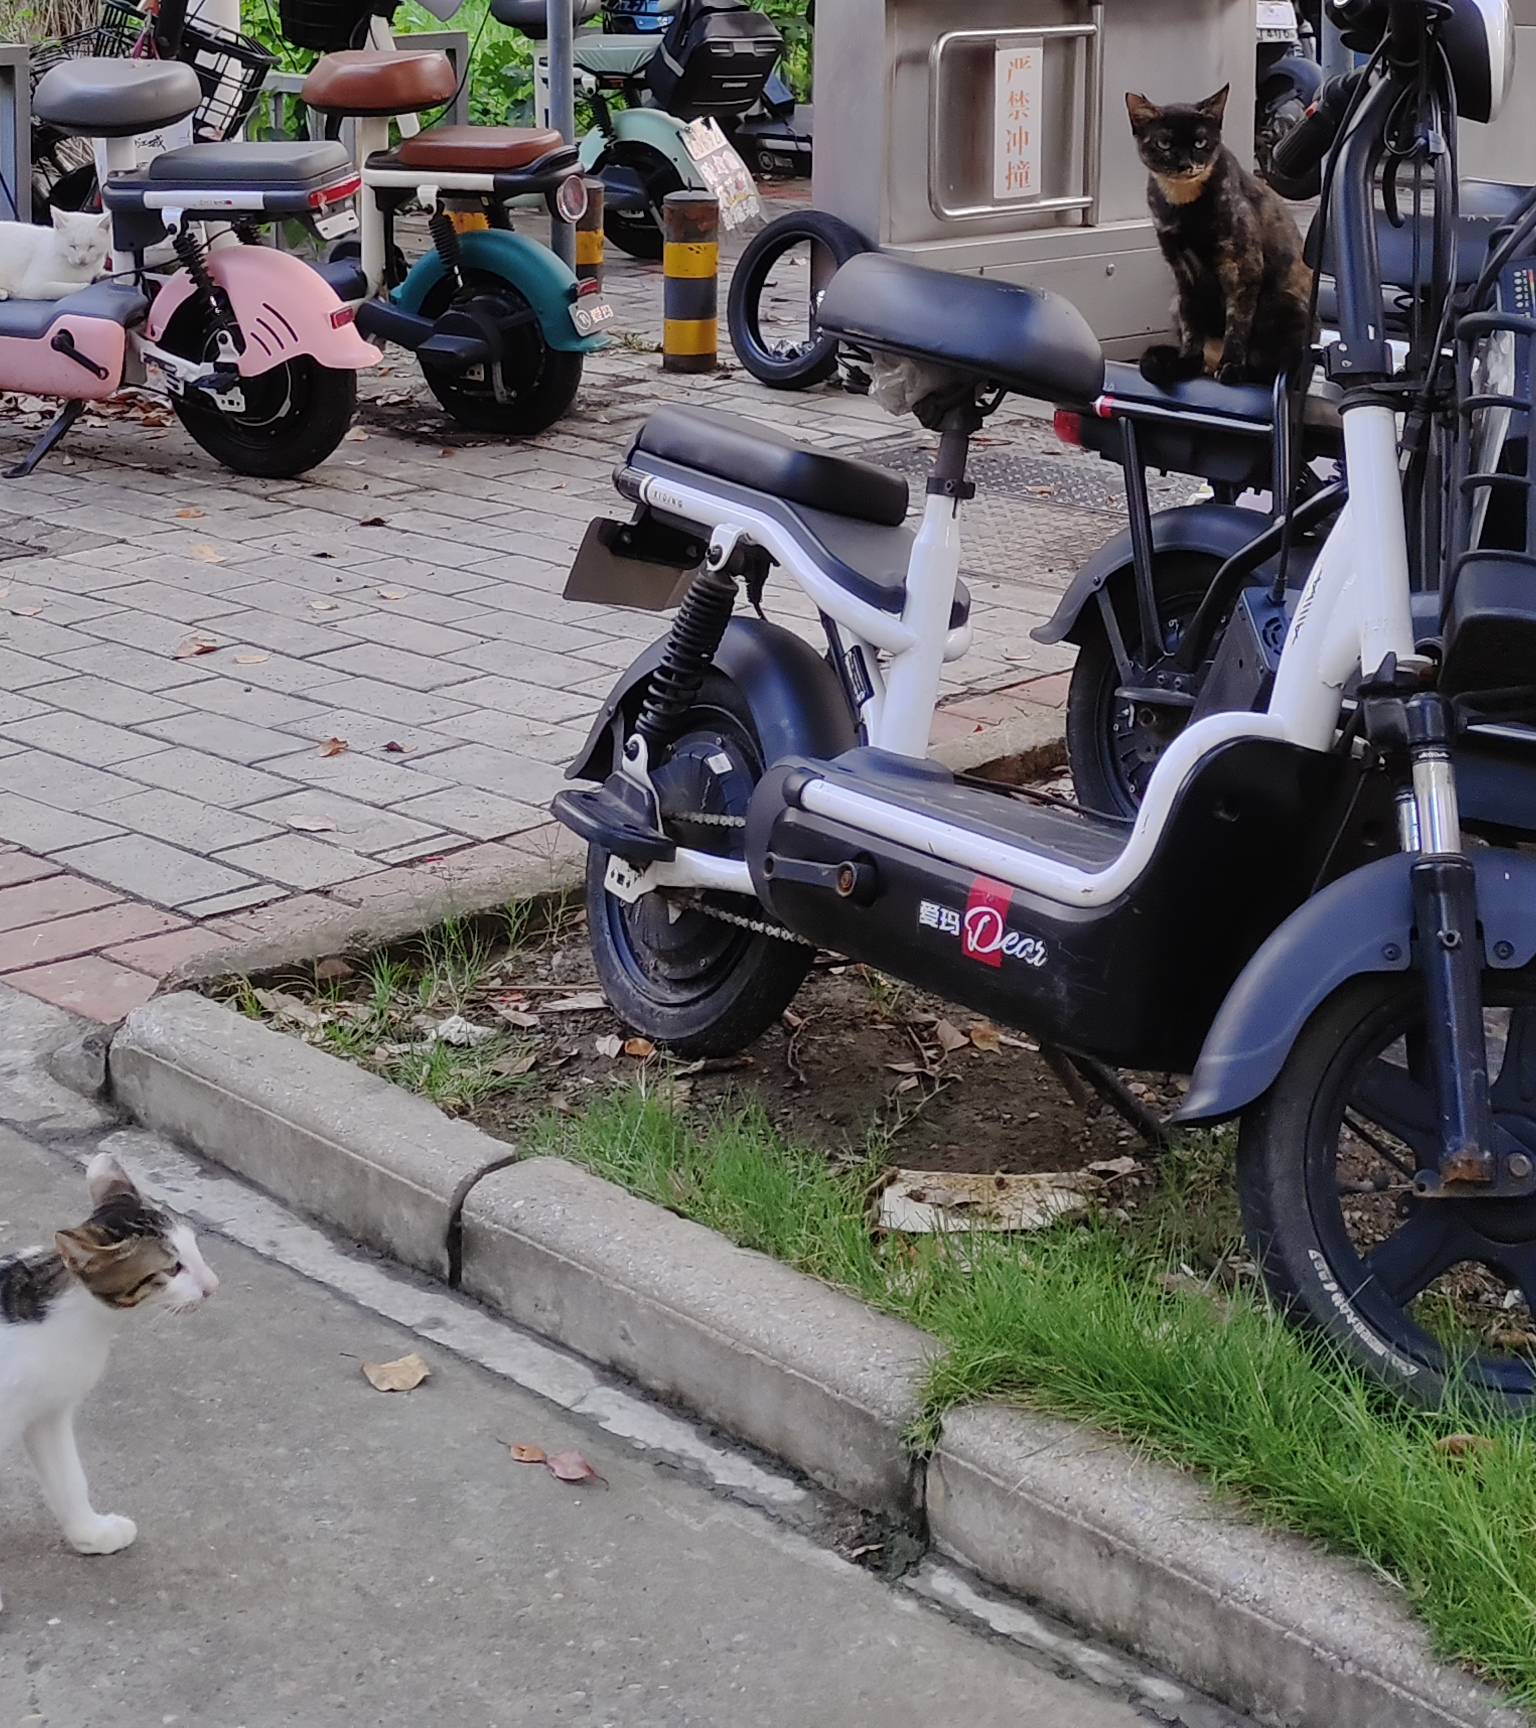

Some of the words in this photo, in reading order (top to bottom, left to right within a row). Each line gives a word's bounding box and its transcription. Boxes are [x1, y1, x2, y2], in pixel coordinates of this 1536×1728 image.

[1005, 55, 1032, 192] 严禁冲撞
[919, 899, 960, 936] 爱玛
